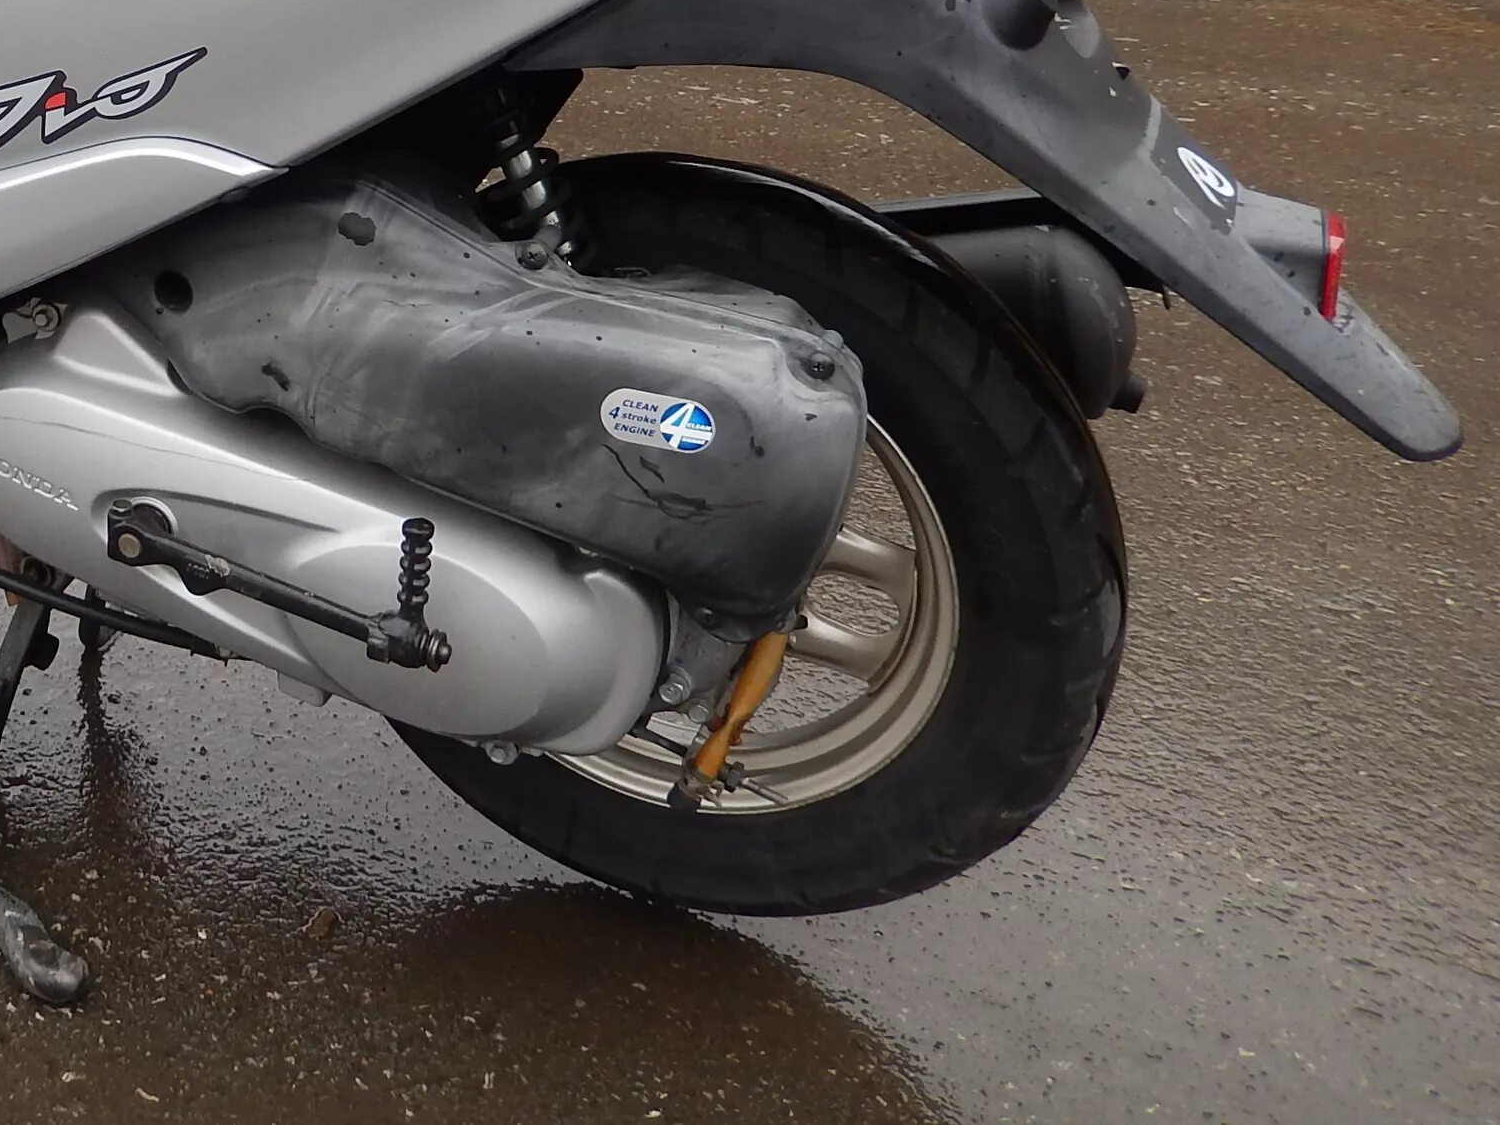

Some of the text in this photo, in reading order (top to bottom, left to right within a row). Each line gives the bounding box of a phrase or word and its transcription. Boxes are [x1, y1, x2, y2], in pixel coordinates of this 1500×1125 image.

[622, 399, 659, 413] CLEAN
[609, 406, 657, 425] 4 stroke
[614, 423, 656, 437] ENGINE
